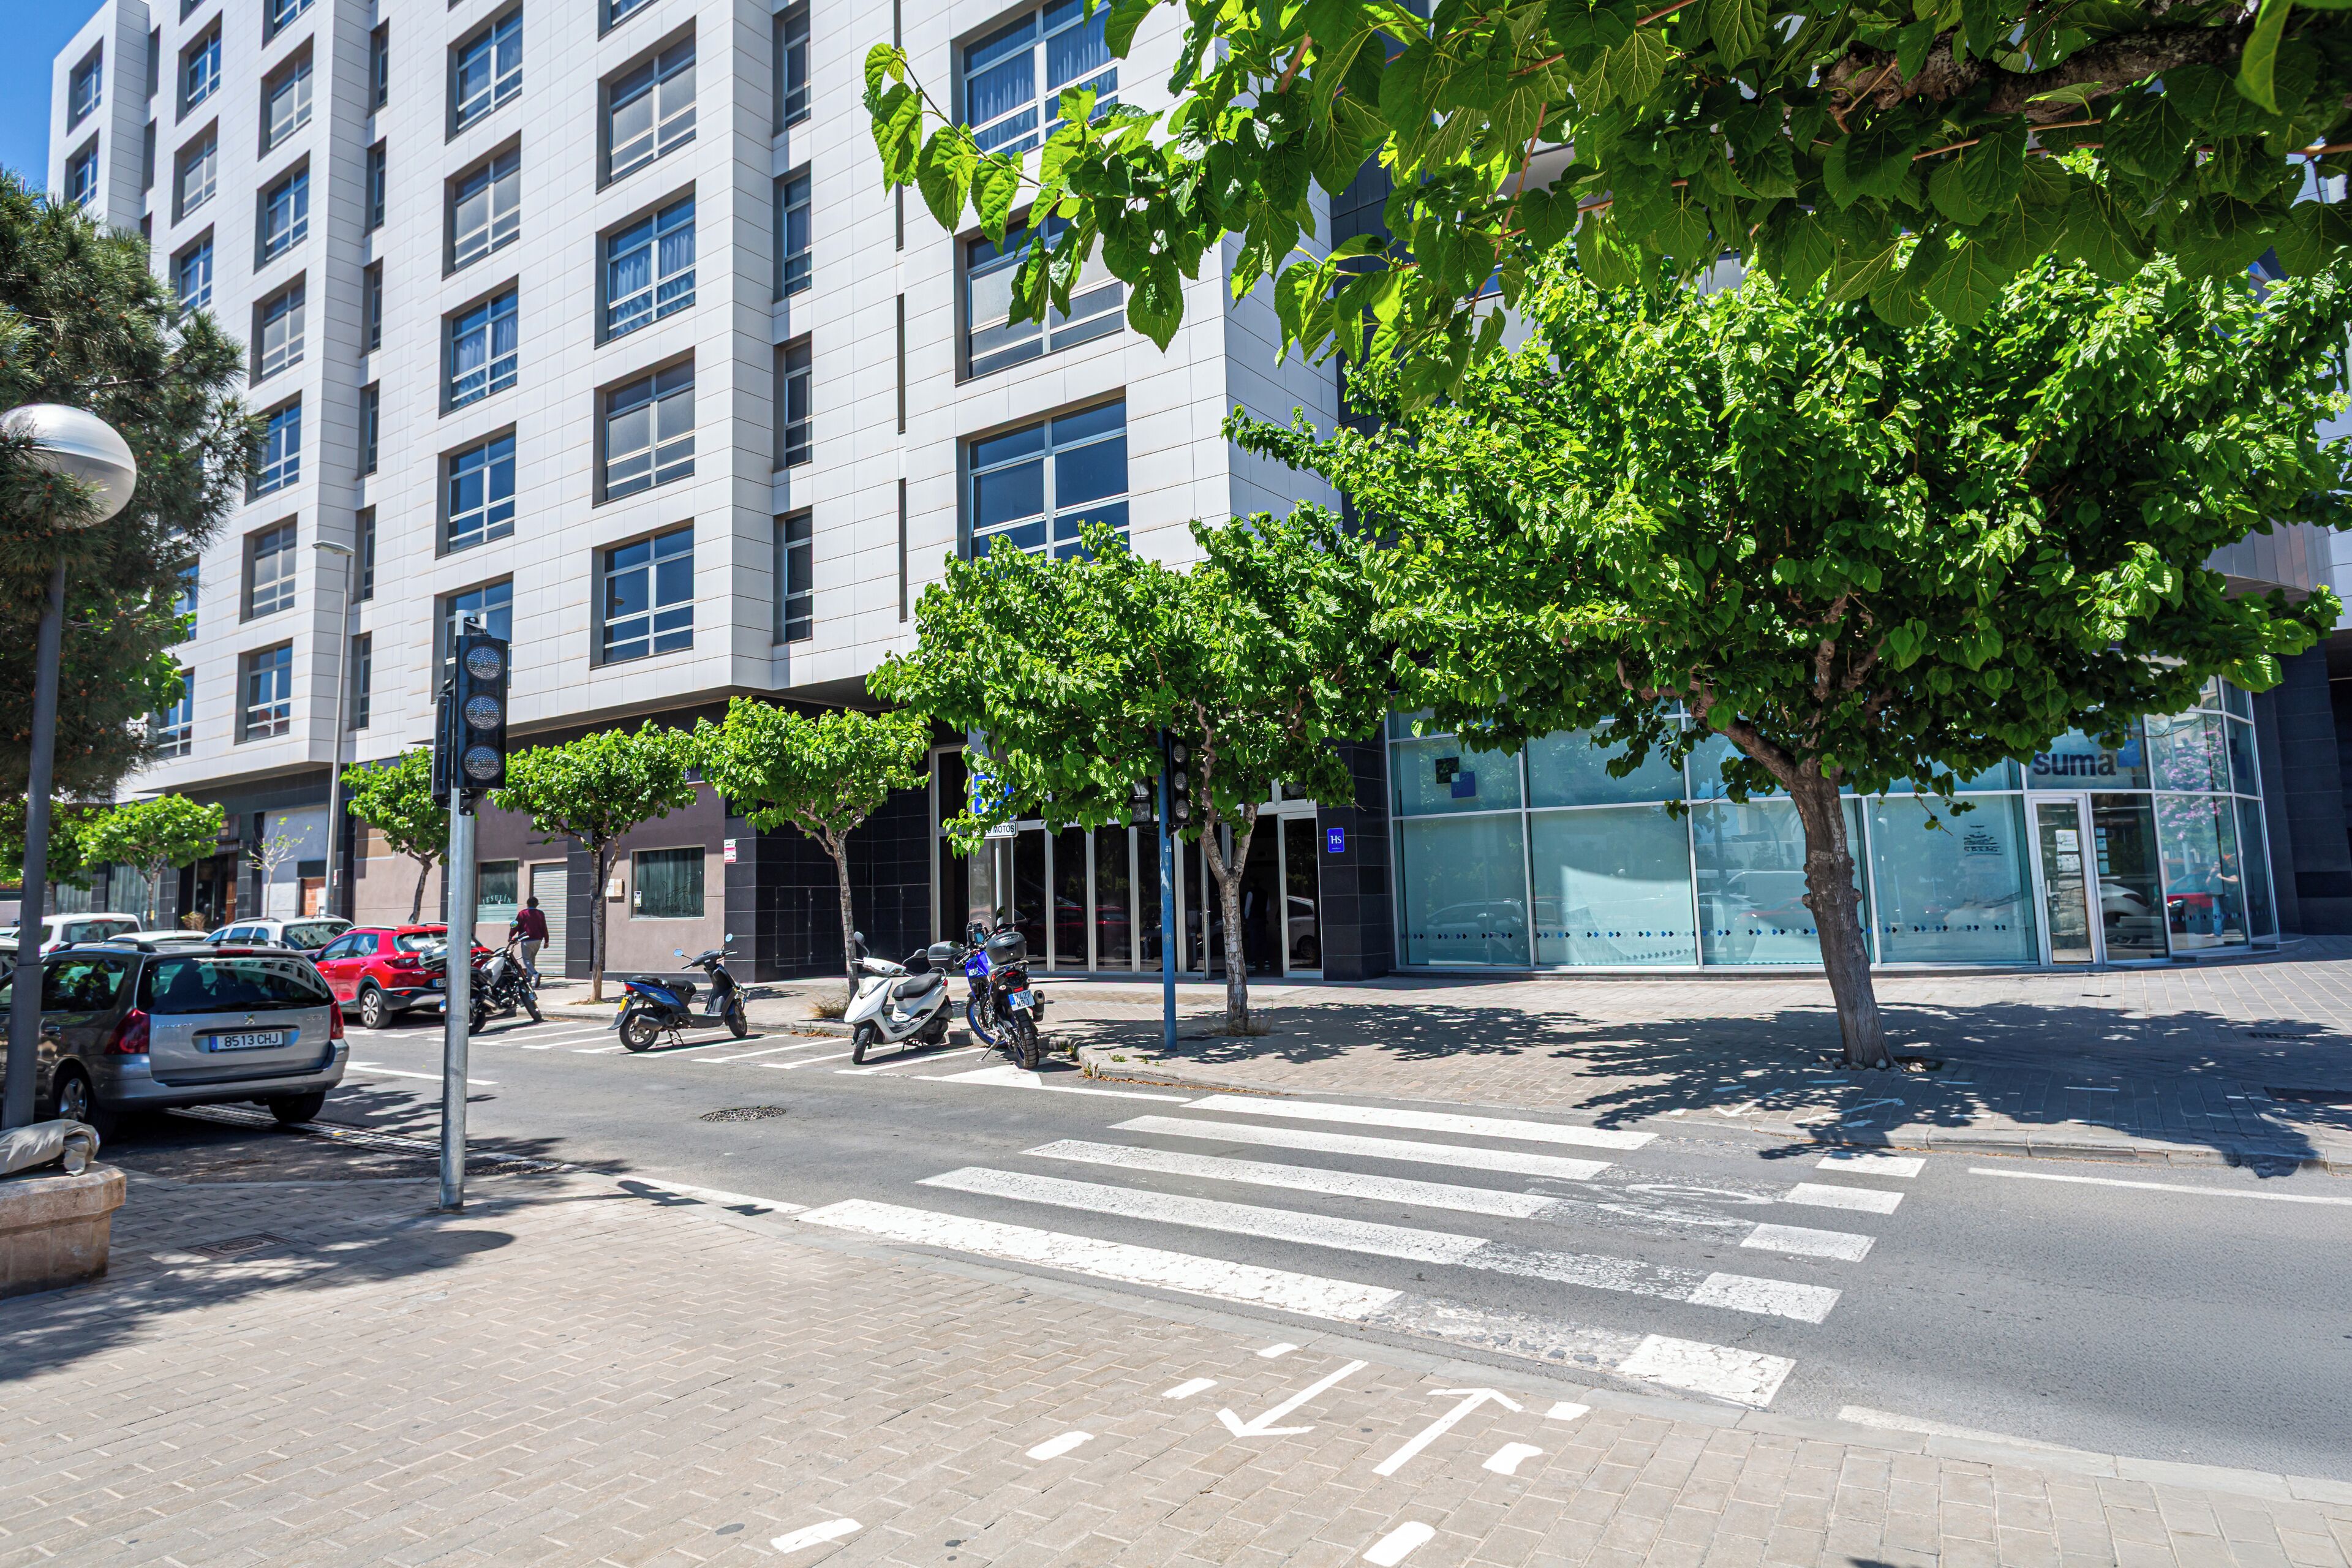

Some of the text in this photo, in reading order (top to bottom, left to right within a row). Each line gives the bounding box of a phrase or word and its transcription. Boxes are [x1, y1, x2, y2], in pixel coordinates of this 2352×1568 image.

[2033, 753, 2116, 775] suma
[1014, 991, 1030, 1001] 7427
[1017, 998, 1030, 1008] MBJ
[224, 1033, 278, 1047] 8513 CHJ
